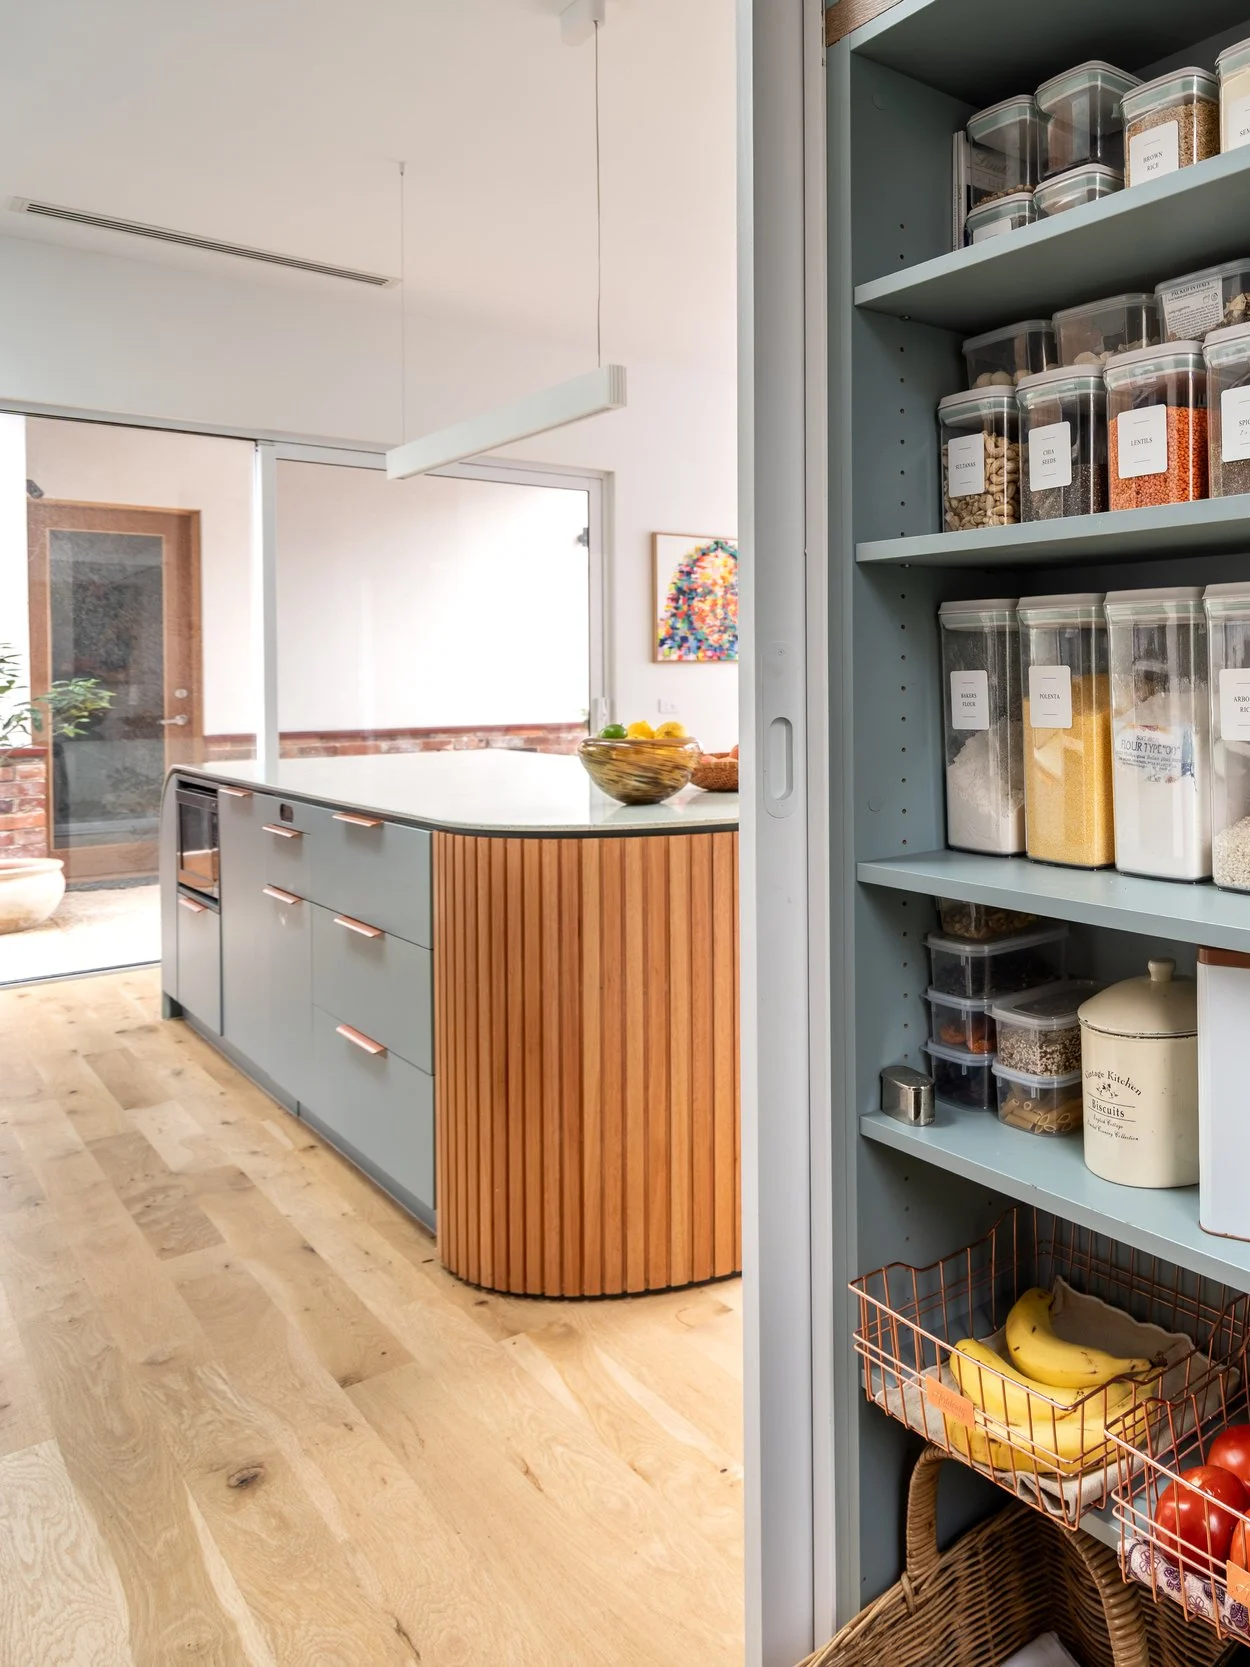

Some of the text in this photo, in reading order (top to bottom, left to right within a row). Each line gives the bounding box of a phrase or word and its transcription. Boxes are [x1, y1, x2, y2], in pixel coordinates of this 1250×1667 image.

[1142, 151, 1164, 164] BROWN
[1146, 162, 1160, 172] RICE
[1130, 437, 1153, 447] LENTILS
[1107, 1070, 1142, 1096] Kitchen
[1091, 1098, 1125, 1118] Biscuits
